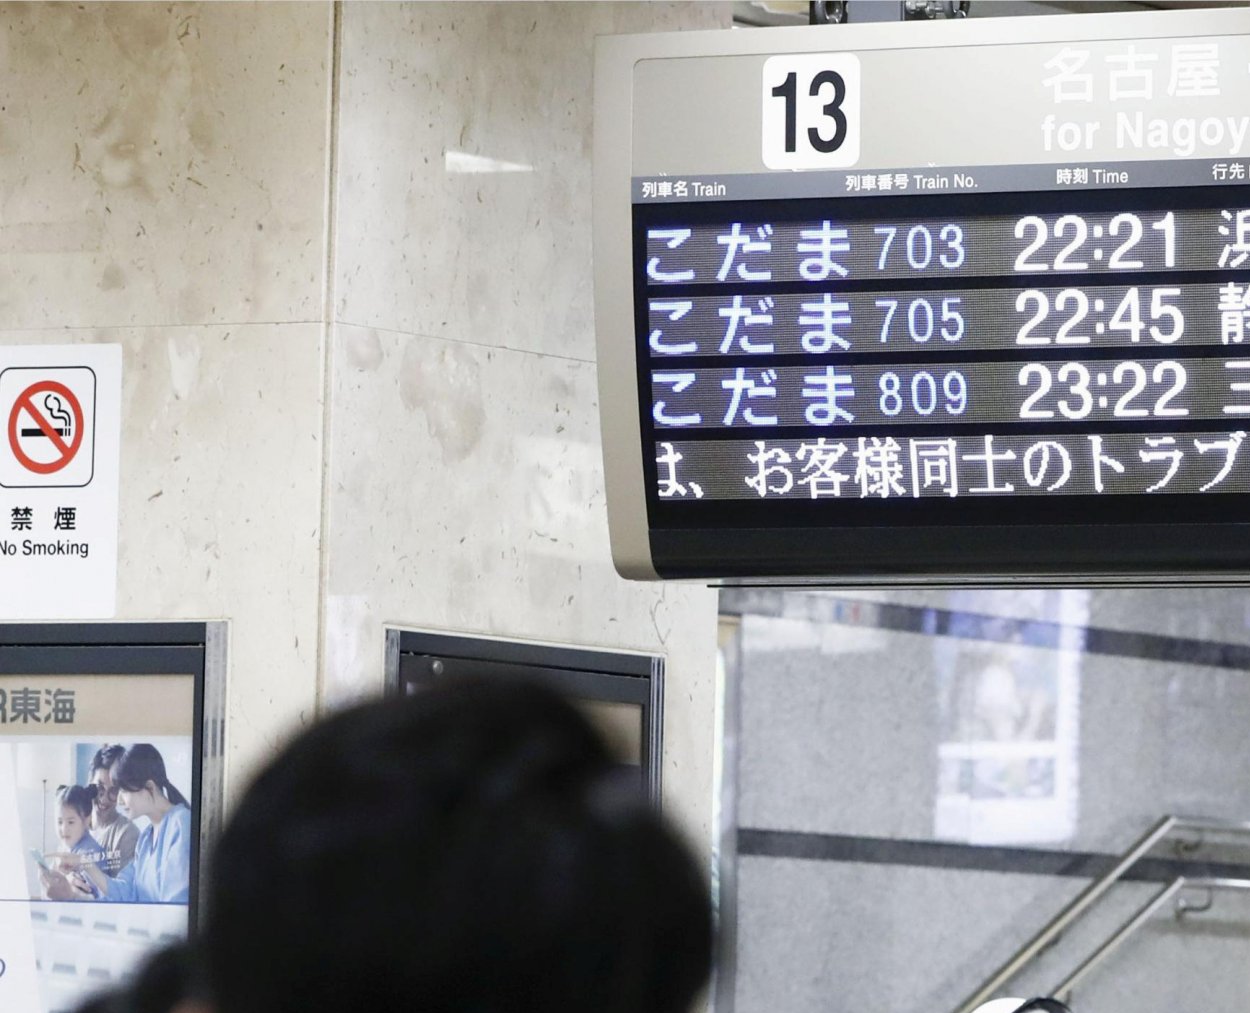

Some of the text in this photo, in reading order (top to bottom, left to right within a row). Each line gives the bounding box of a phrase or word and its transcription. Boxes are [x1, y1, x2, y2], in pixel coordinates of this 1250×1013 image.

[772, 70, 847, 153] 13
[1042, 112, 1100, 151] for
[846, 174, 977, 191] 列車番号 Train No.
[1057, 168, 1128, 184] 時刻 Time
[1213, 163, 1244, 180] 行先
[642, 181, 725, 197] 列車名 Train
[647, 221, 851, 283] こだま
[874, 224, 967, 269] 703
[1013, 212, 1177, 271] 22:21
[649, 293, 854, 354] こだま
[875, 298, 964, 343] 705
[1015, 287, 1185, 345] 22:45
[653, 366, 855, 426] こだま
[879, 371, 966, 415] 809
[1018, 361, 1189, 419] 23:22
[12, 507, 76, 530] 禁煙
[0, 538, 88, 558] No Smoking
